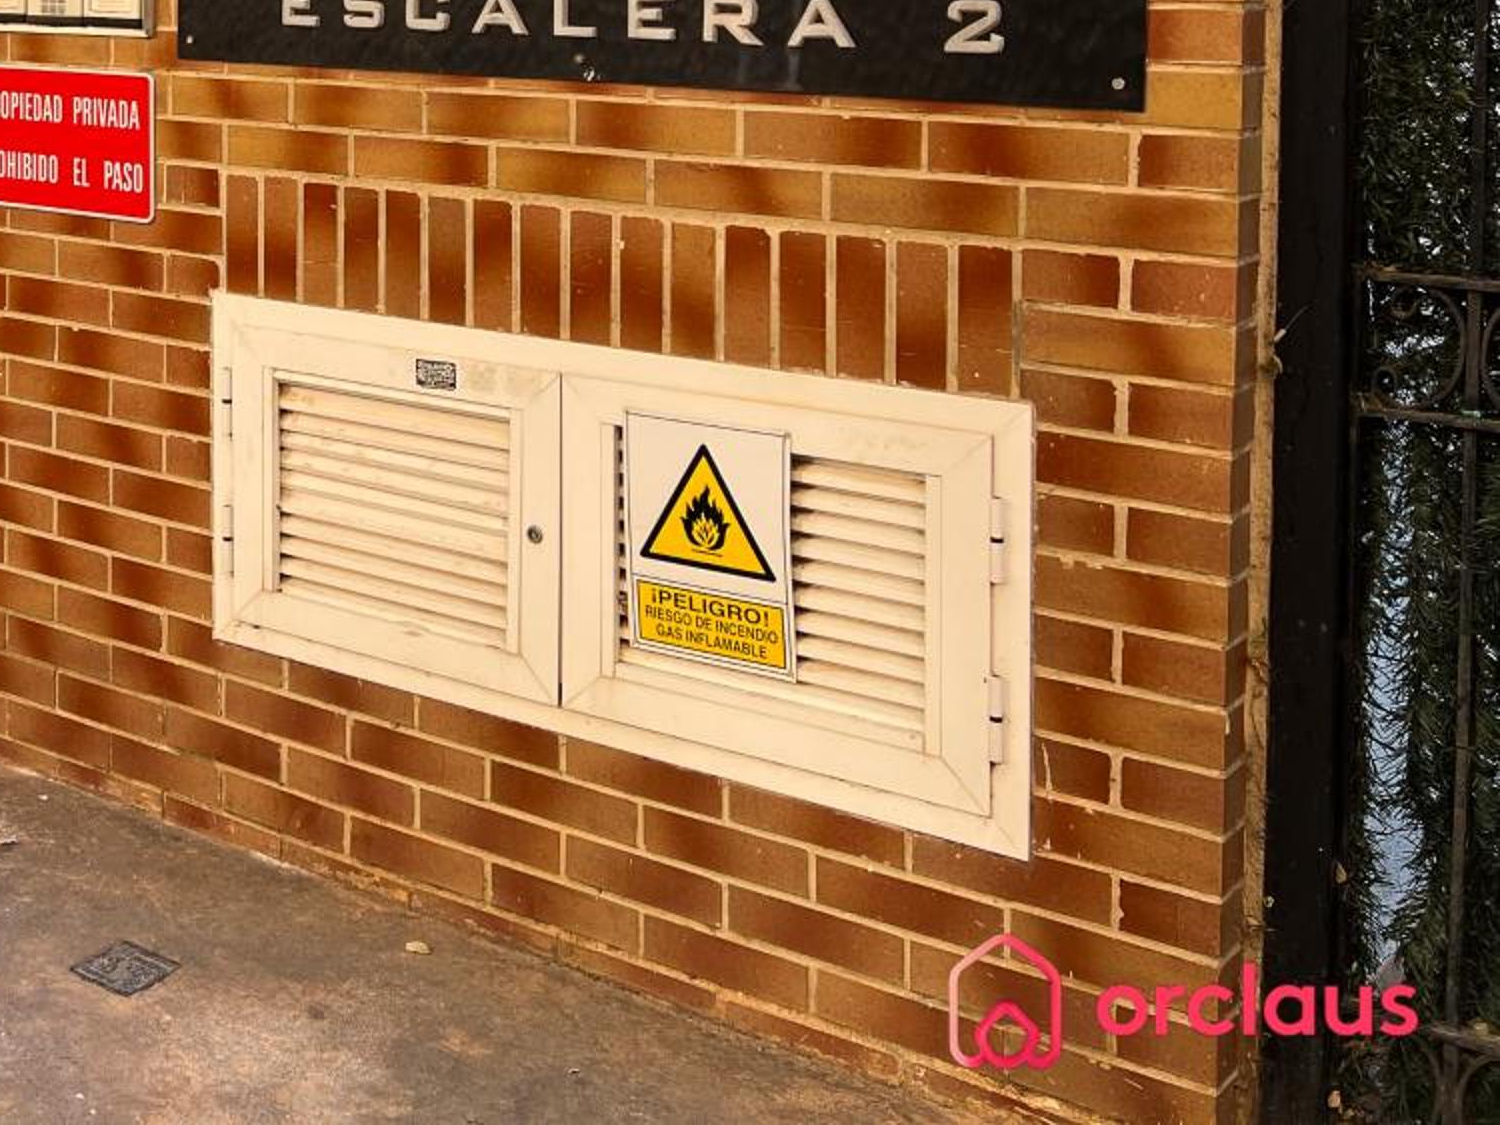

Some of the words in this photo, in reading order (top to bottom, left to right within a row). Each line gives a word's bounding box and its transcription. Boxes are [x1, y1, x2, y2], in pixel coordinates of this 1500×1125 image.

[73, 96, 141, 130] PRIVADA
[73, 158, 90, 188] EL
[104, 160, 144, 194] PASO
[645, 605, 692, 626] RIESGO
[695, 615, 712, 631] DE
[715, 621, 778, 644] INCENDIO
[651, 588, 769, 627] ¡PELIGRO!
[655, 623, 682, 640] GAS
[685, 630, 767, 659] INFLAMABLE
